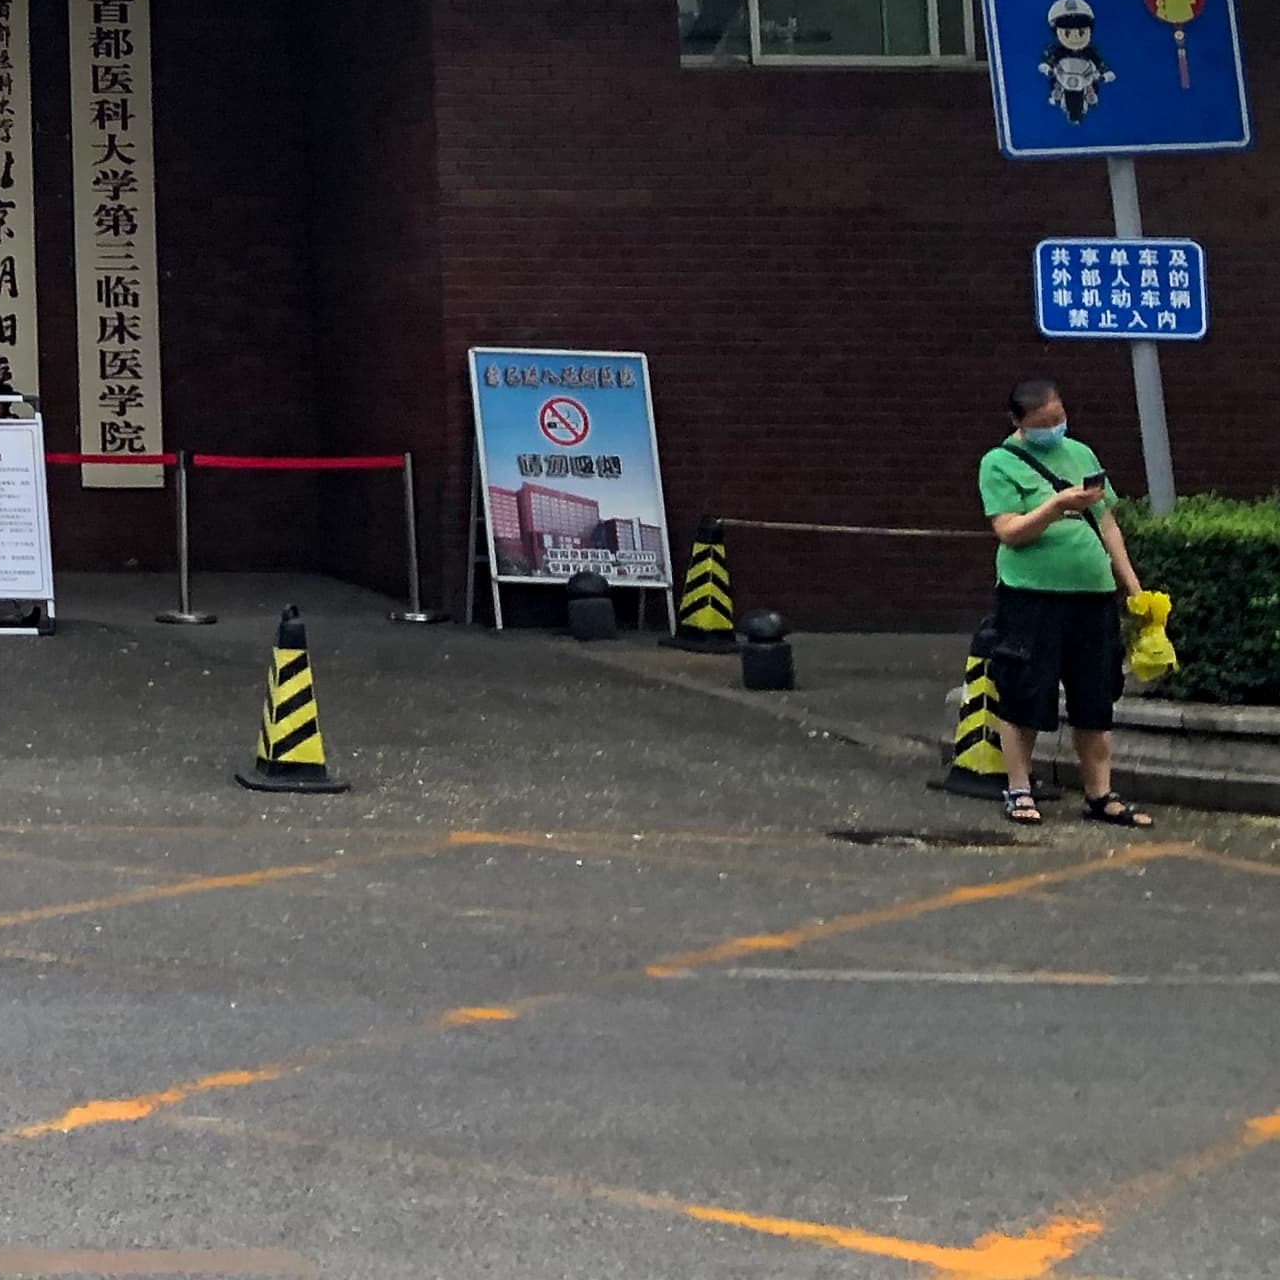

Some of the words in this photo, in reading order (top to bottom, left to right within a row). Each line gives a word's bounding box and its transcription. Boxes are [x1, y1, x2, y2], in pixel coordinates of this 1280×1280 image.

[1051, 247, 1188, 268] 共享单车及
[1052, 268, 1189, 288] 外部人员的
[1053, 289, 1190, 309] 非机动车辆
[1068, 309, 1176, 330] 禁止入内
